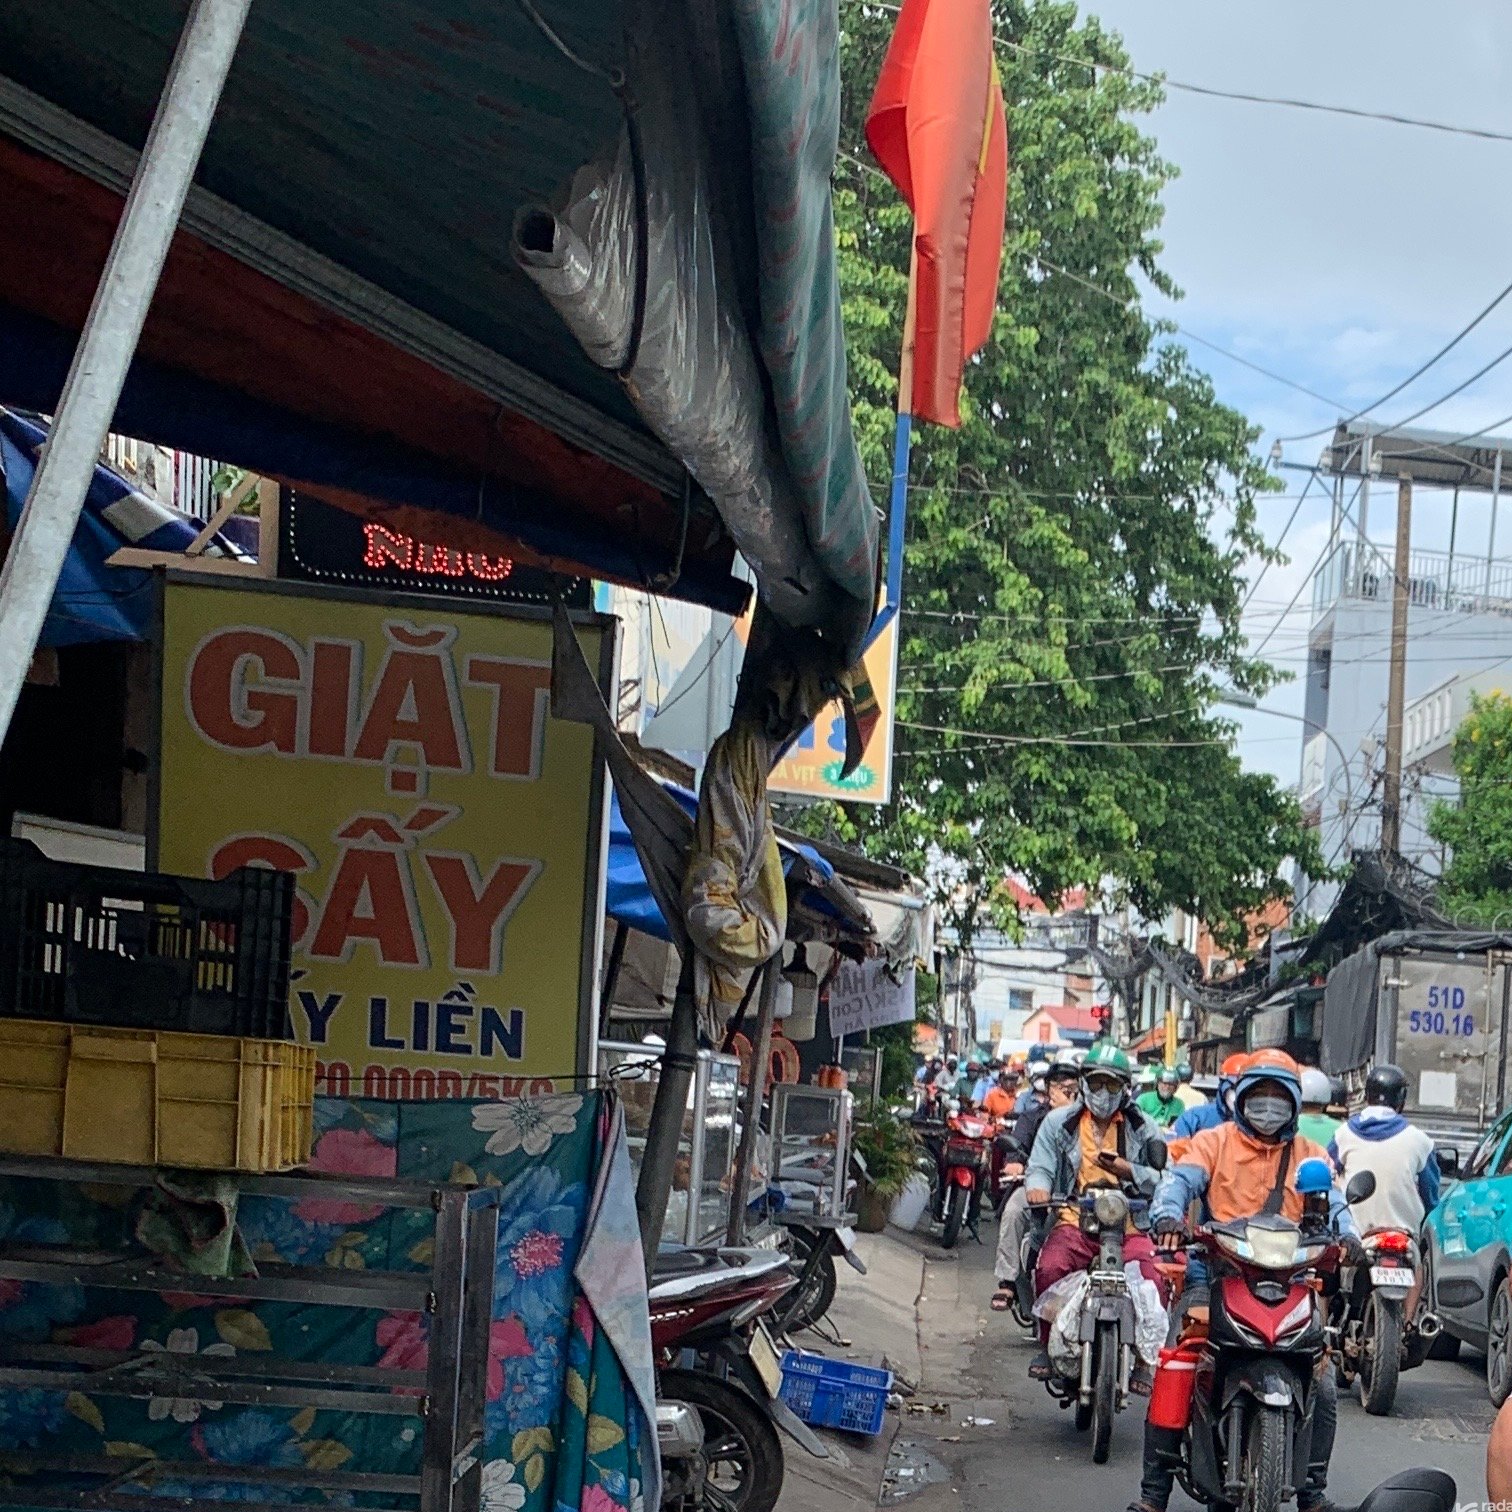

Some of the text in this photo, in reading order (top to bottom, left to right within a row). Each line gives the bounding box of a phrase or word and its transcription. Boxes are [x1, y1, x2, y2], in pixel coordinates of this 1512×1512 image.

[187, 622, 554, 795] GIẶT
[367, 980, 525, 1061] LIỀN
[1409, 1010, 1474, 1036] 530.16
[1428, 986, 1465, 1009] 51D
